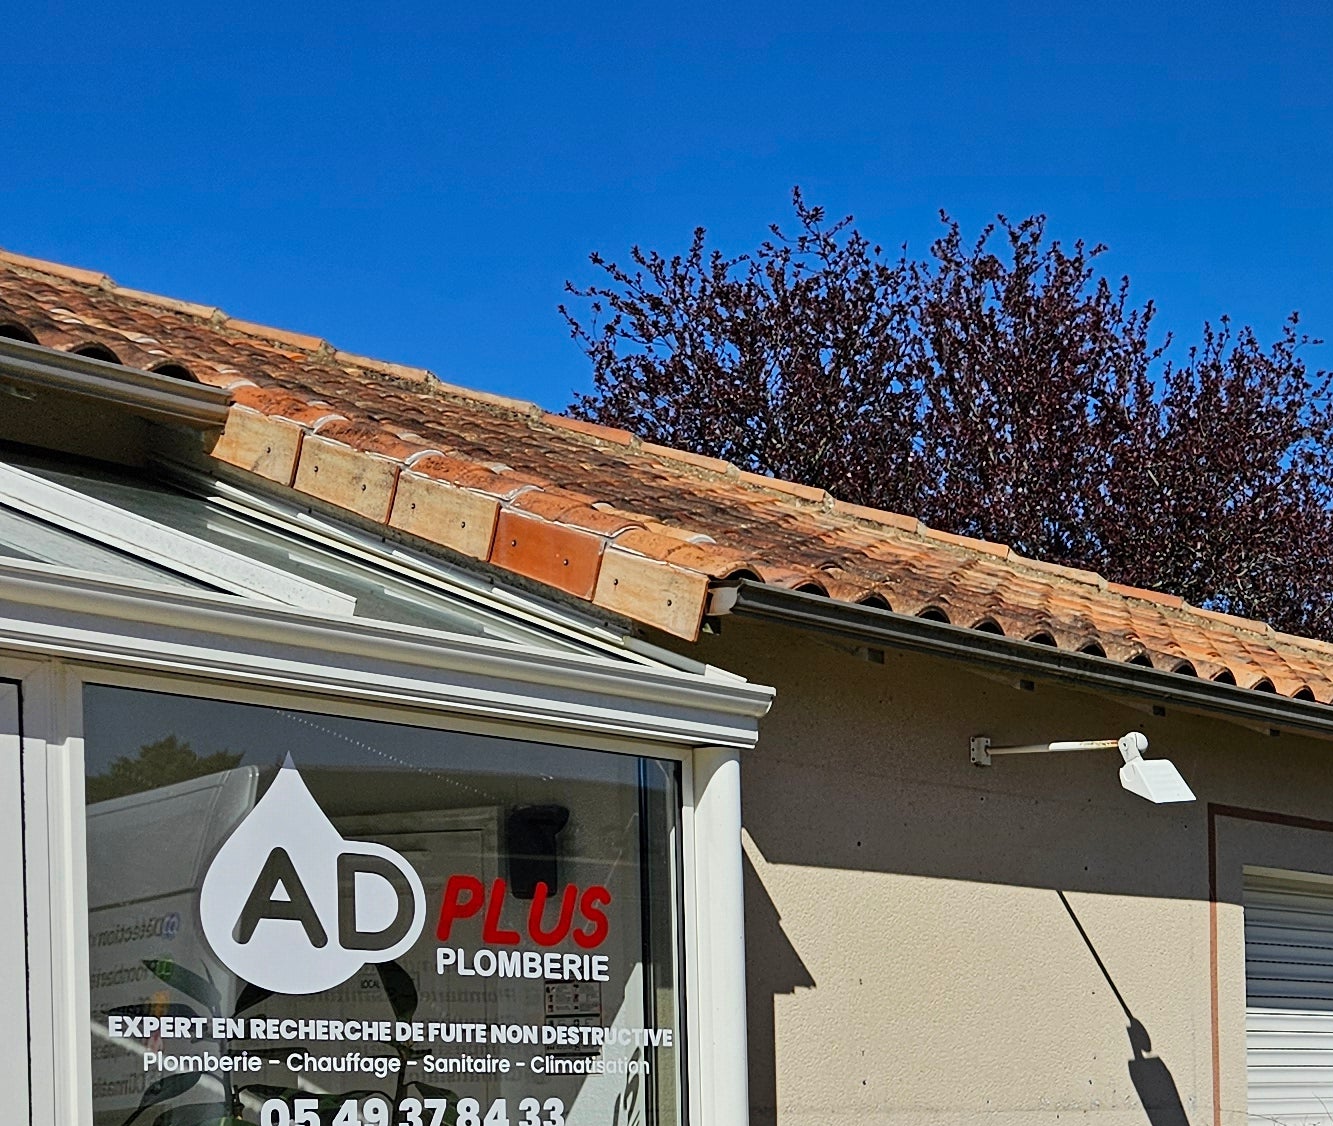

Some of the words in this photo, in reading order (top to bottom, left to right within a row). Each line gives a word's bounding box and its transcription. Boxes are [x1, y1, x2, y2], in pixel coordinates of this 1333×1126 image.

[231, 846, 417, 951] AD
[436, 874, 612, 949] PLUS
[435, 947, 610, 982] PLOMBERIE
[108, 1015, 207, 1039] EXPERT
[212, 1017, 245, 1039] EN
[250, 1018, 392, 1042] RECHERCHE
[395, 1021, 425, 1042] DE
[428, 1022, 487, 1044] FUITE
[491, 1024, 538, 1045] NON
[541, 1025, 674, 1047] DESTRUCTIVE
[142, 1050, 263, 1073] Plomberie
[286, 1052, 401, 1079] Chauffage
[423, 1054, 511, 1074] Sanitaire
[530, 1055, 651, 1075] Climatisation
